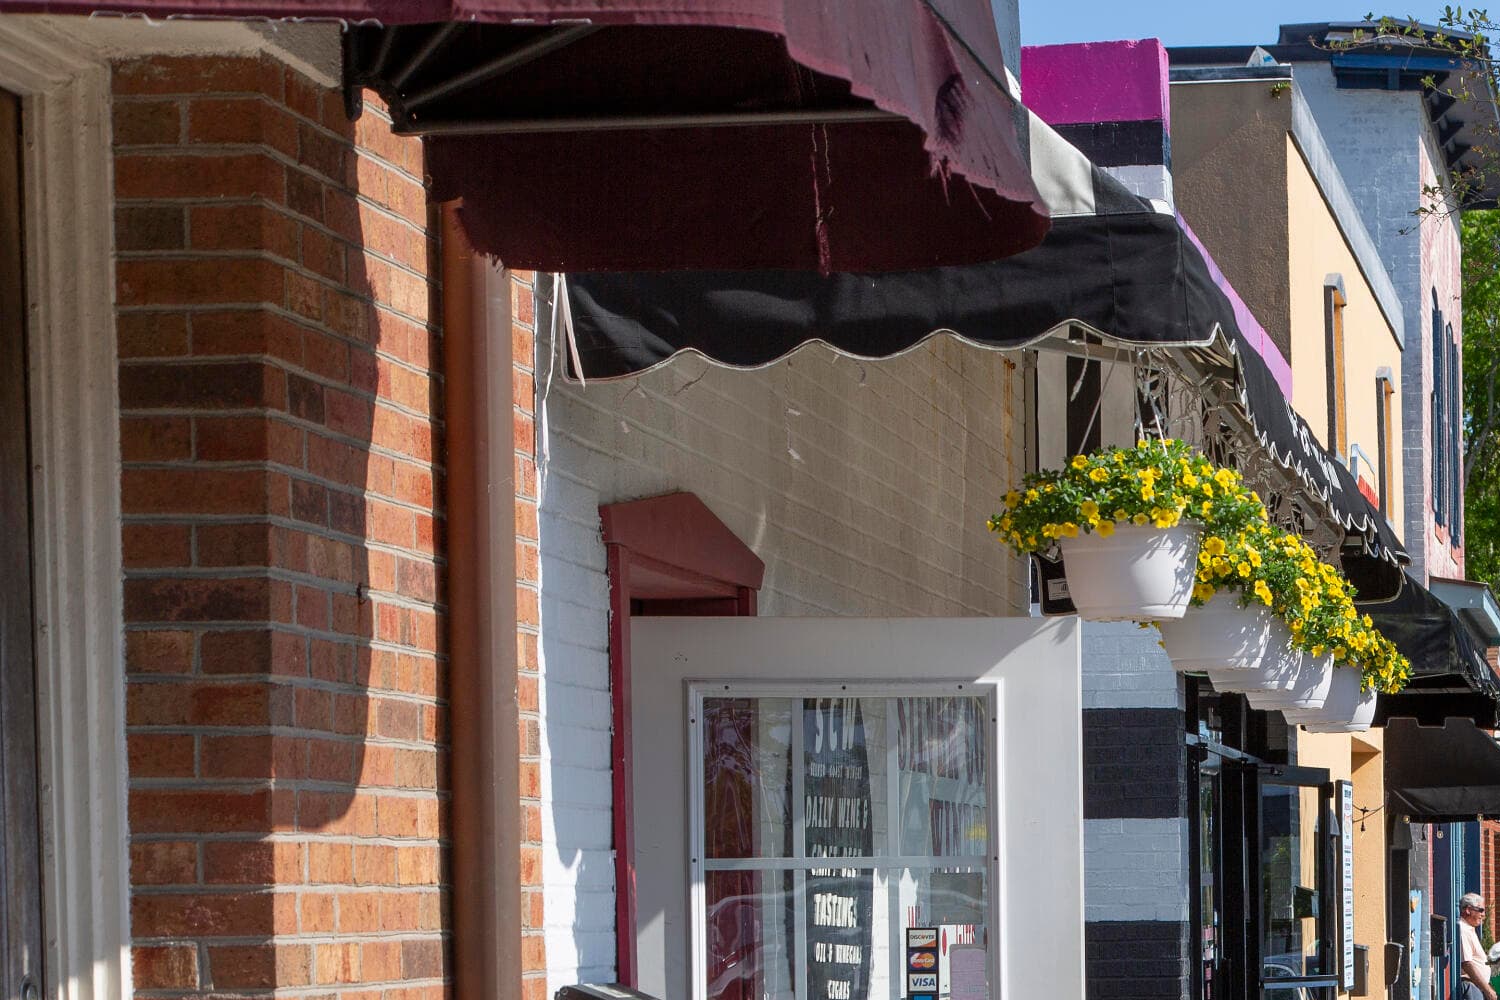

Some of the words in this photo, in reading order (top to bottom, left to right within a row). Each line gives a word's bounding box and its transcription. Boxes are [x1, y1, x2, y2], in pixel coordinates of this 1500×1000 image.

[806, 796, 834, 828] DAILY
[838, 798, 861, 828] WINE
[815, 942, 826, 962] OIL
[827, 979, 850, 1000] CIGARS
[912, 977, 935, 987] VISA
